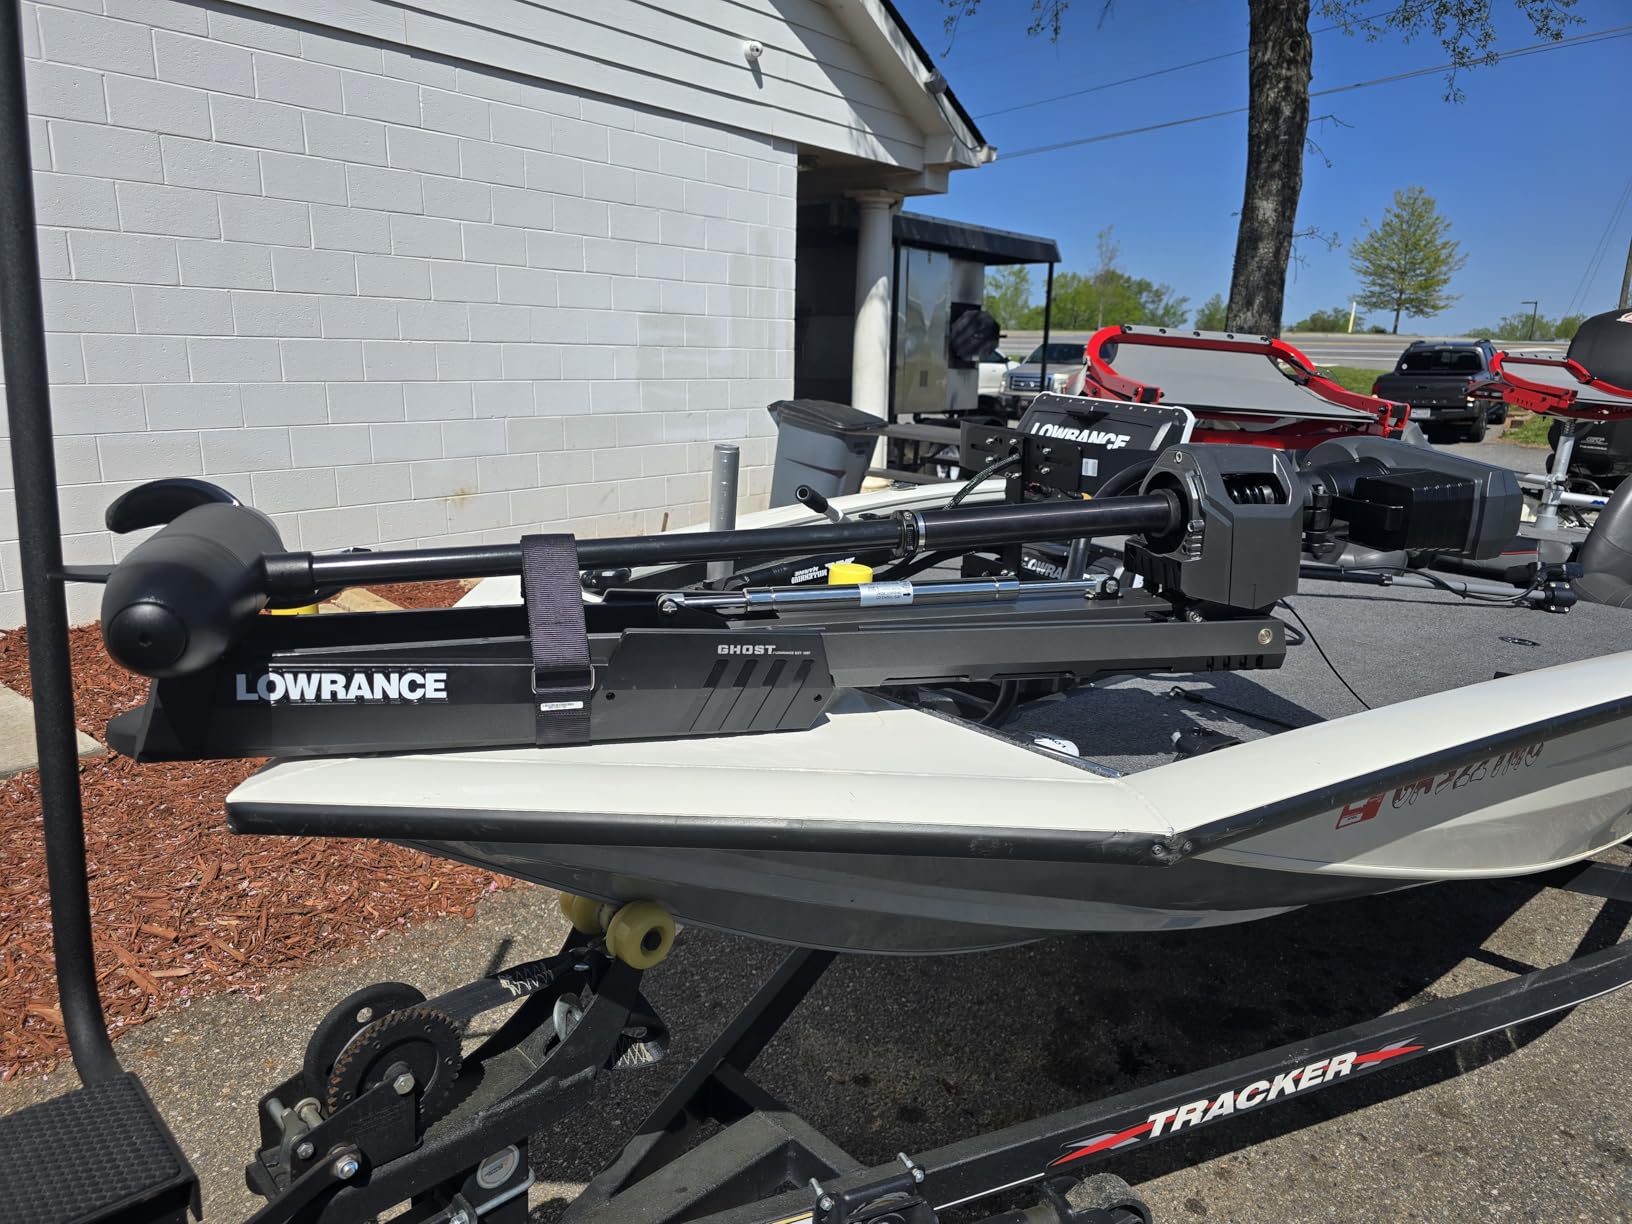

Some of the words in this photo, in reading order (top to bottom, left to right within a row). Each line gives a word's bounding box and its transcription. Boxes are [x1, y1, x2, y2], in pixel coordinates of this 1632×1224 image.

[1030, 422, 1131, 450] LOWRANCE
[717, 645, 776, 655] GHOST
[235, 672, 448, 701] LOWRANCE
[1146, 1050, 1358, 1139] TRACKER
